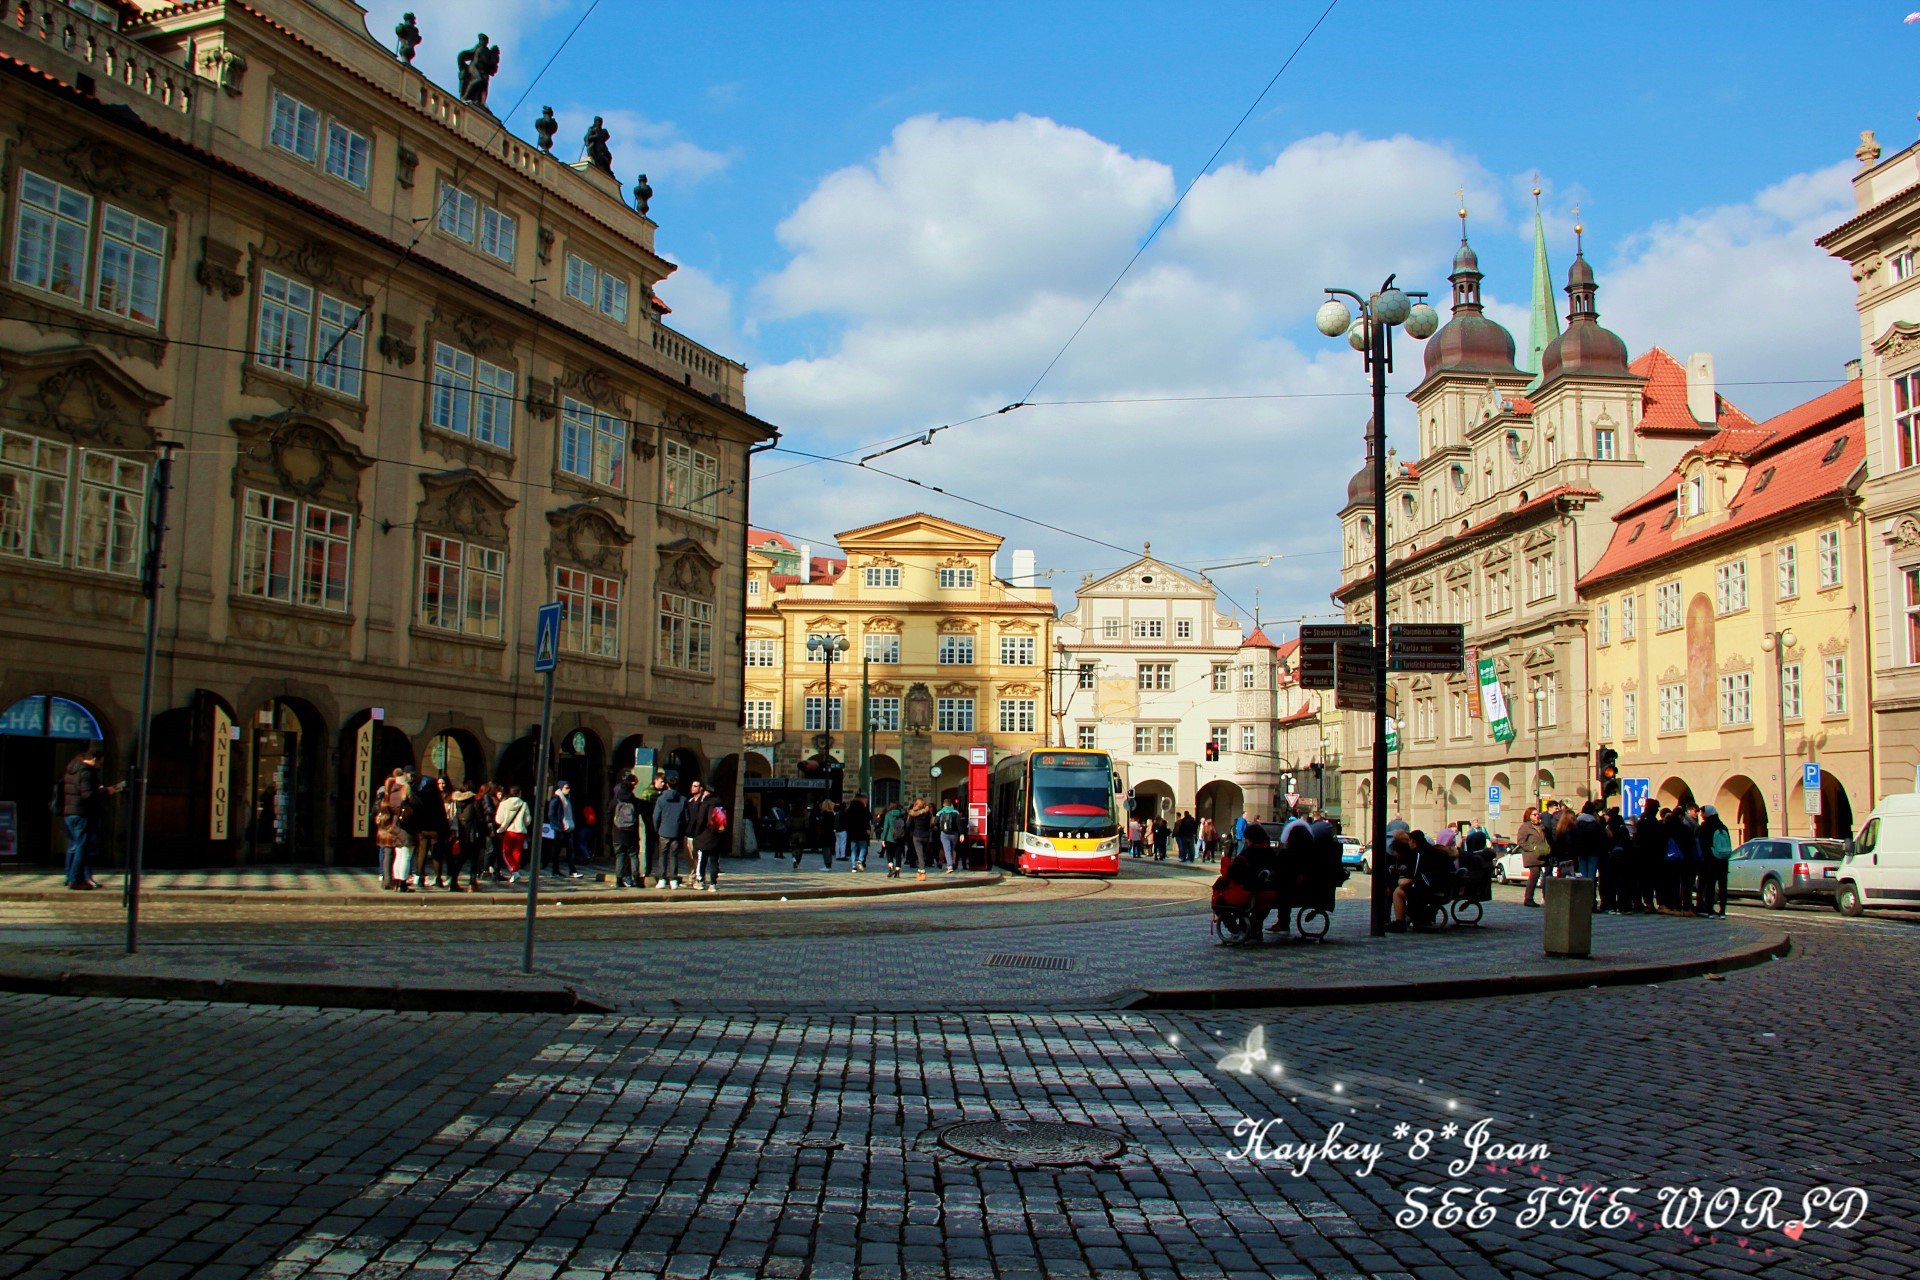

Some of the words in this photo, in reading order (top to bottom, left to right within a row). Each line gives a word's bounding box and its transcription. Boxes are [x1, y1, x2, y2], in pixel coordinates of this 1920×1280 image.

[215, 721, 228, 833] ANTIQUE
[357, 731, 370, 832] ANTIQUE
[1042, 755, 1055, 765] 20
